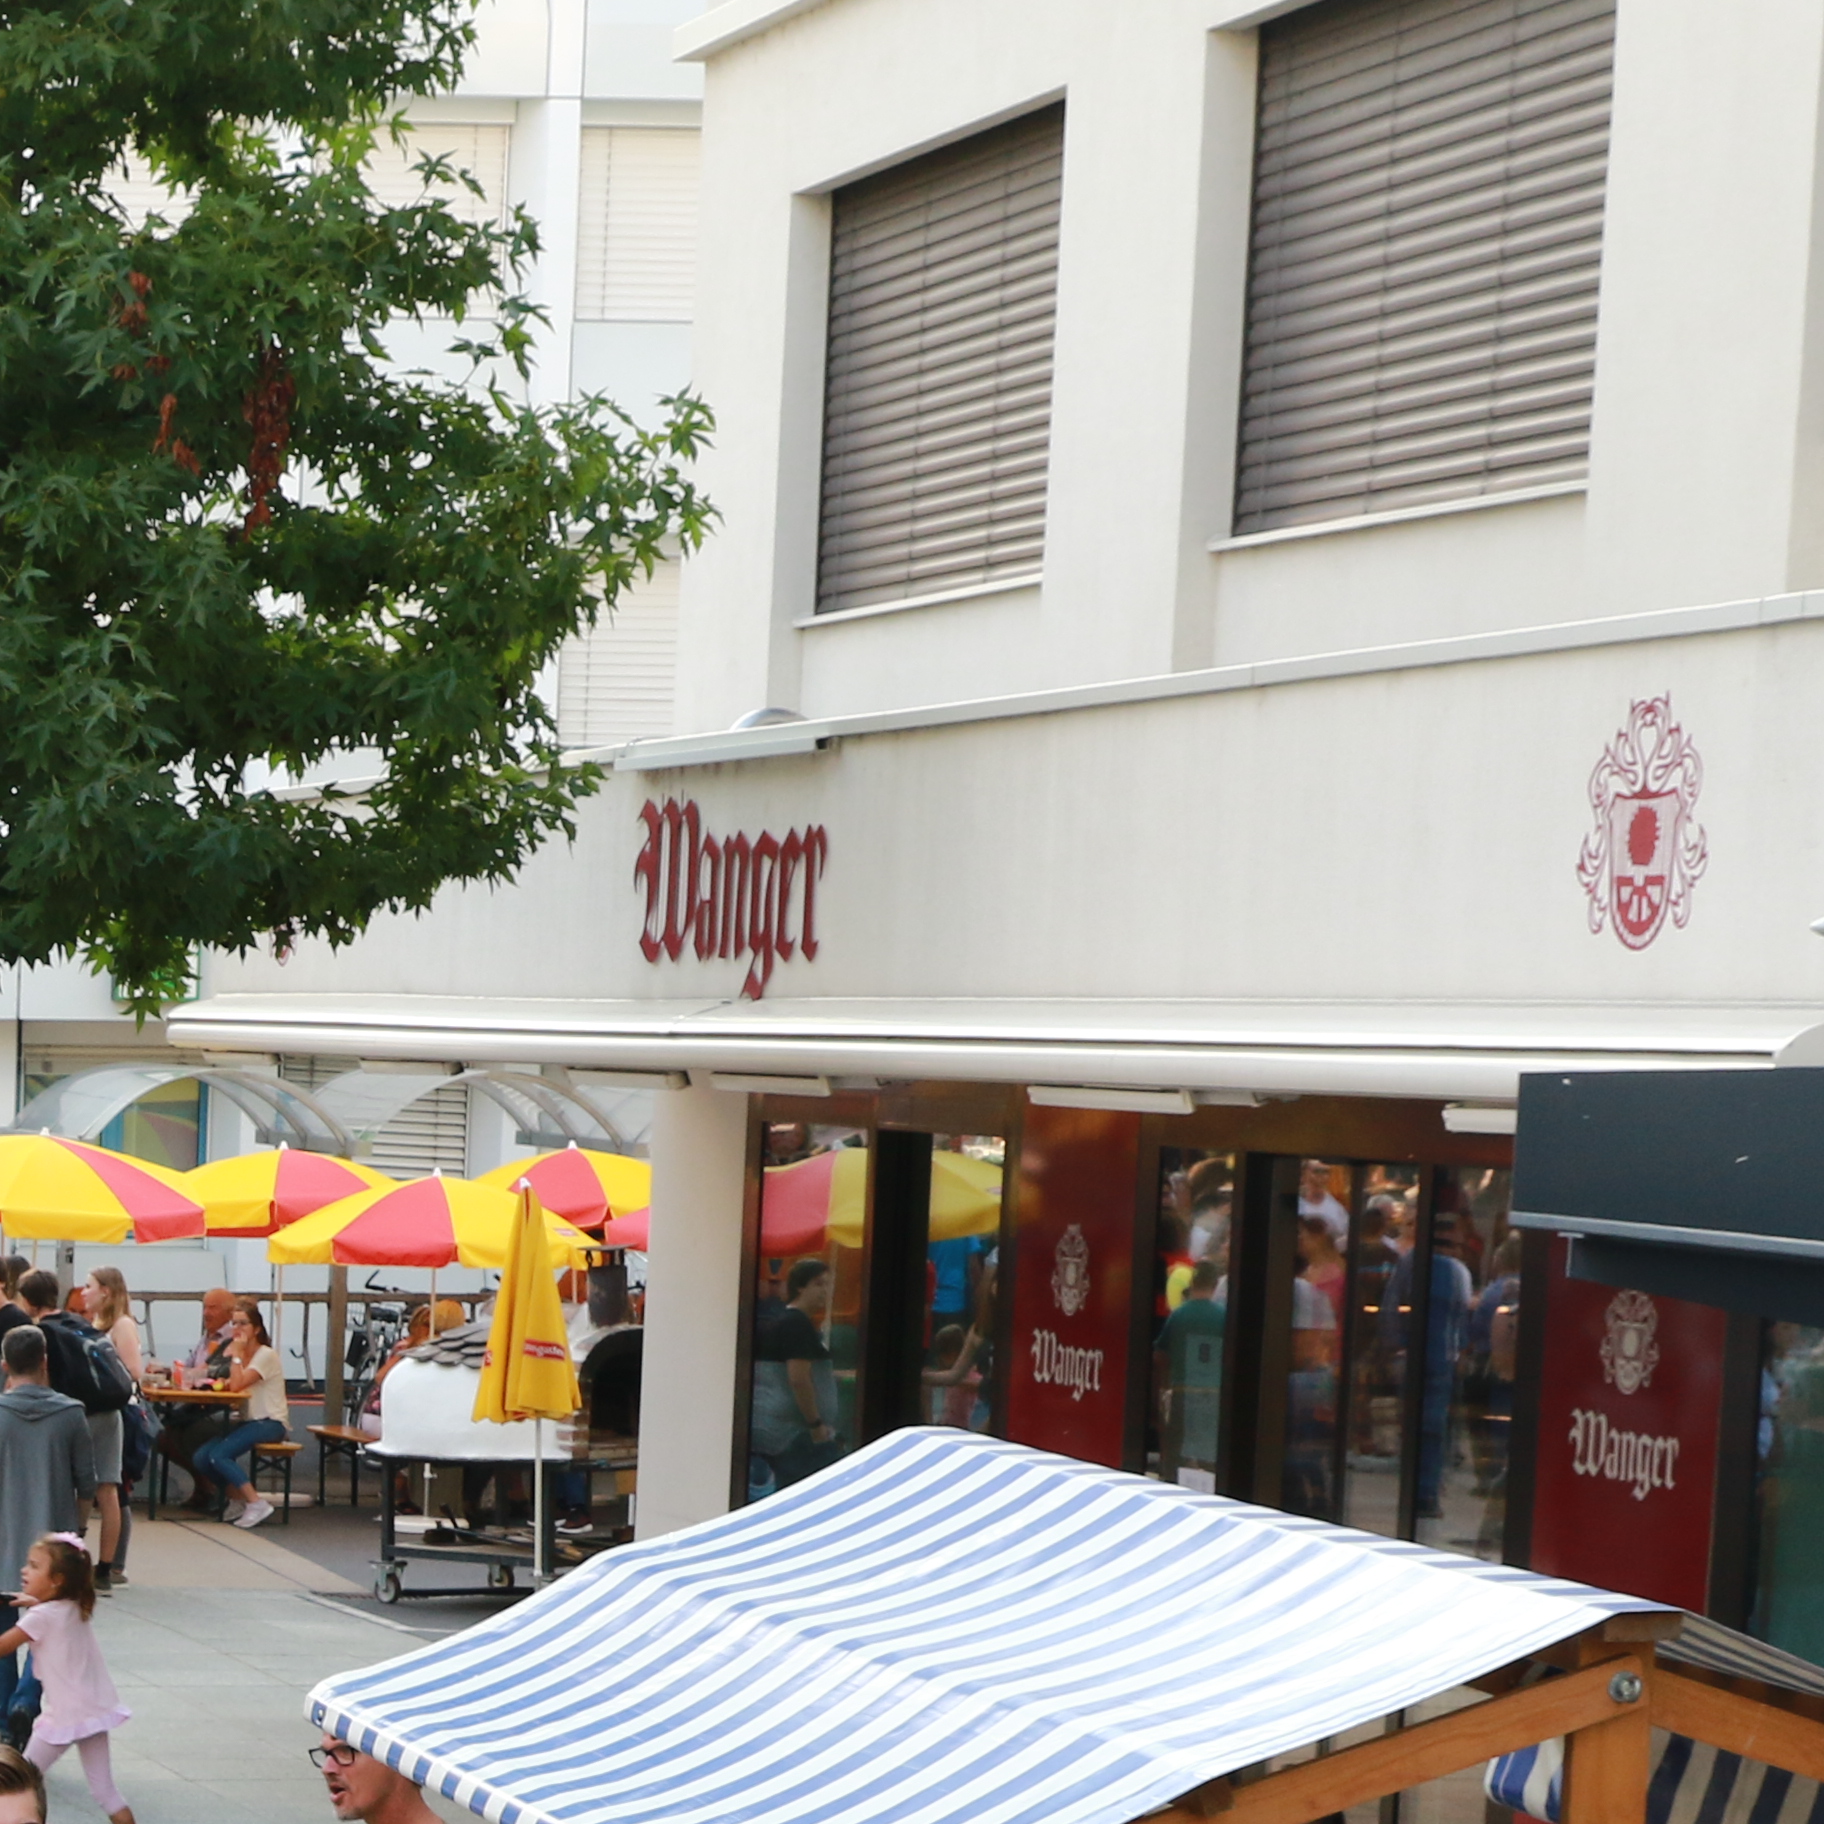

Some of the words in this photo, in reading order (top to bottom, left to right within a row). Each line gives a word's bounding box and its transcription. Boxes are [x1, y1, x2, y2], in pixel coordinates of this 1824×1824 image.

[635, 793, 828, 1002] Wanger
[1030, 1327, 1104, 1402] Wanger
[1568, 1407, 1680, 1501] Wanger
